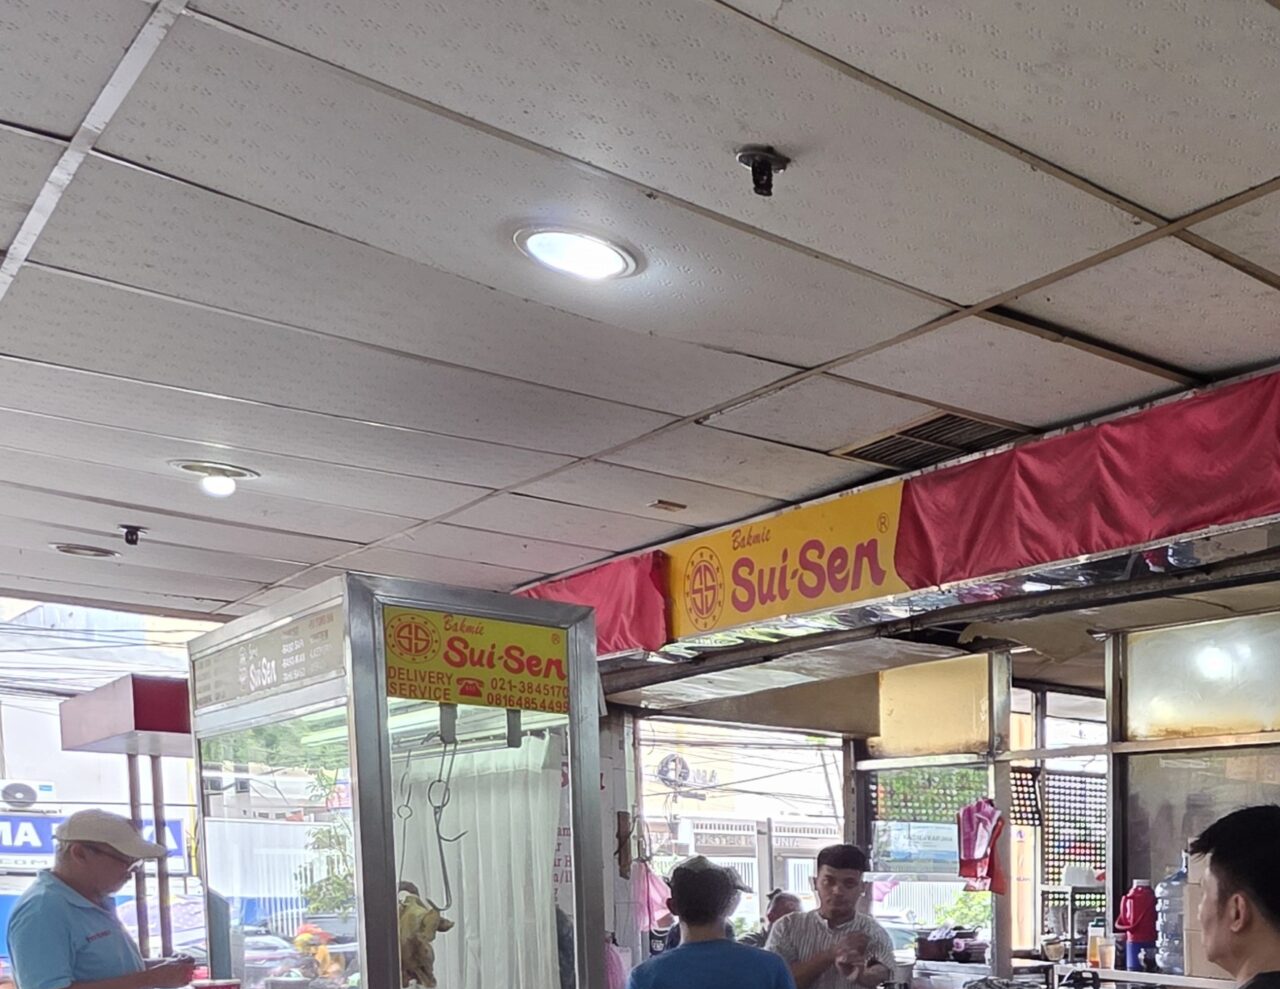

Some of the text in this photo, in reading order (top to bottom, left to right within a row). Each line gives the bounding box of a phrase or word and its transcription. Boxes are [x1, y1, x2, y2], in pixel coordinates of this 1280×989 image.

[731, 526, 772, 551] Bakmie
[730, 538, 887, 613] Sui-Sen
[443, 614, 485, 637] Bakmie
[442, 635, 567, 681] Sui-Sen
[387, 665, 453, 686] DELIVERY
[388, 681, 452, 701] SERVICE
